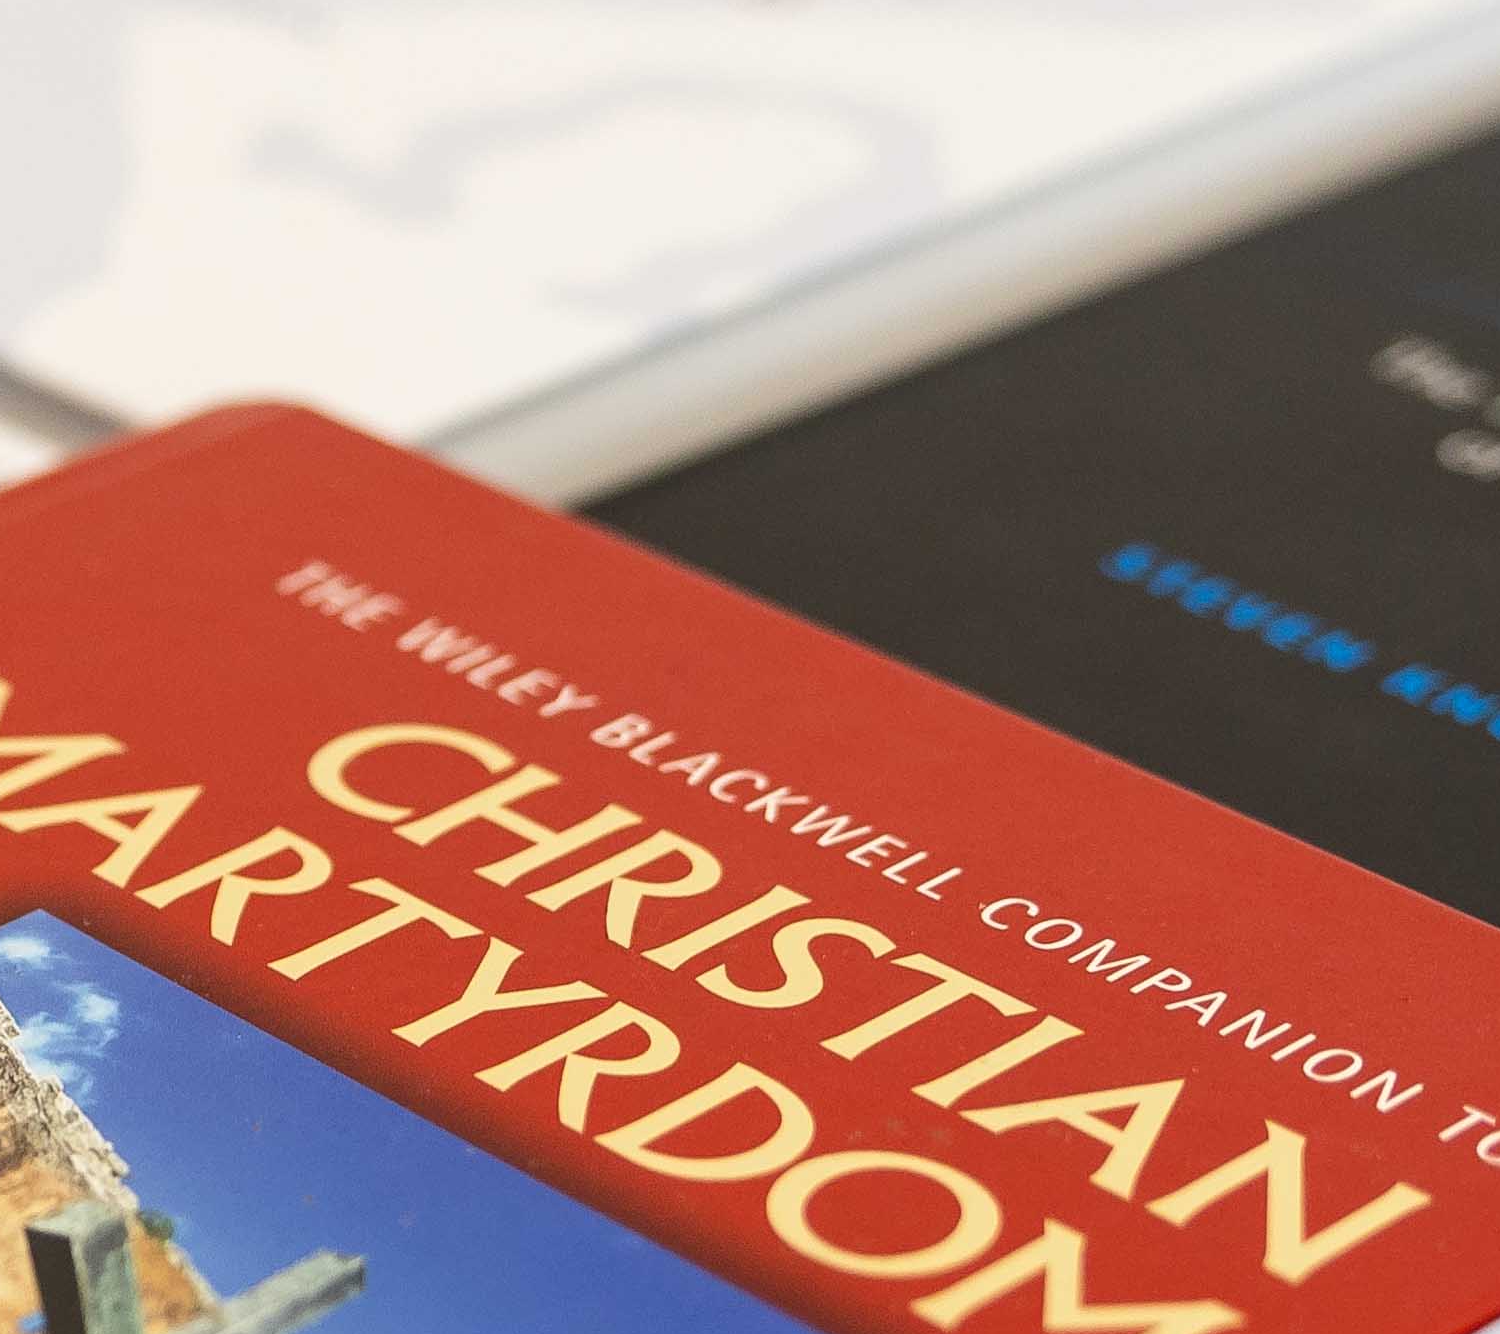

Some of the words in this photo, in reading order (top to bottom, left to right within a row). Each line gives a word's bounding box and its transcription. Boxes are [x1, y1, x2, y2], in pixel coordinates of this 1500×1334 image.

[275, 560, 400, 647] THE
[392, 609, 598, 729] WILEY
[585, 709, 966, 905] BLACKWELL
[980, 895, 1424, 1112] COMPANION
[1098, 541, 1376, 671] STEVEN
[306, 719, 1434, 1285] CHRISTIAN
